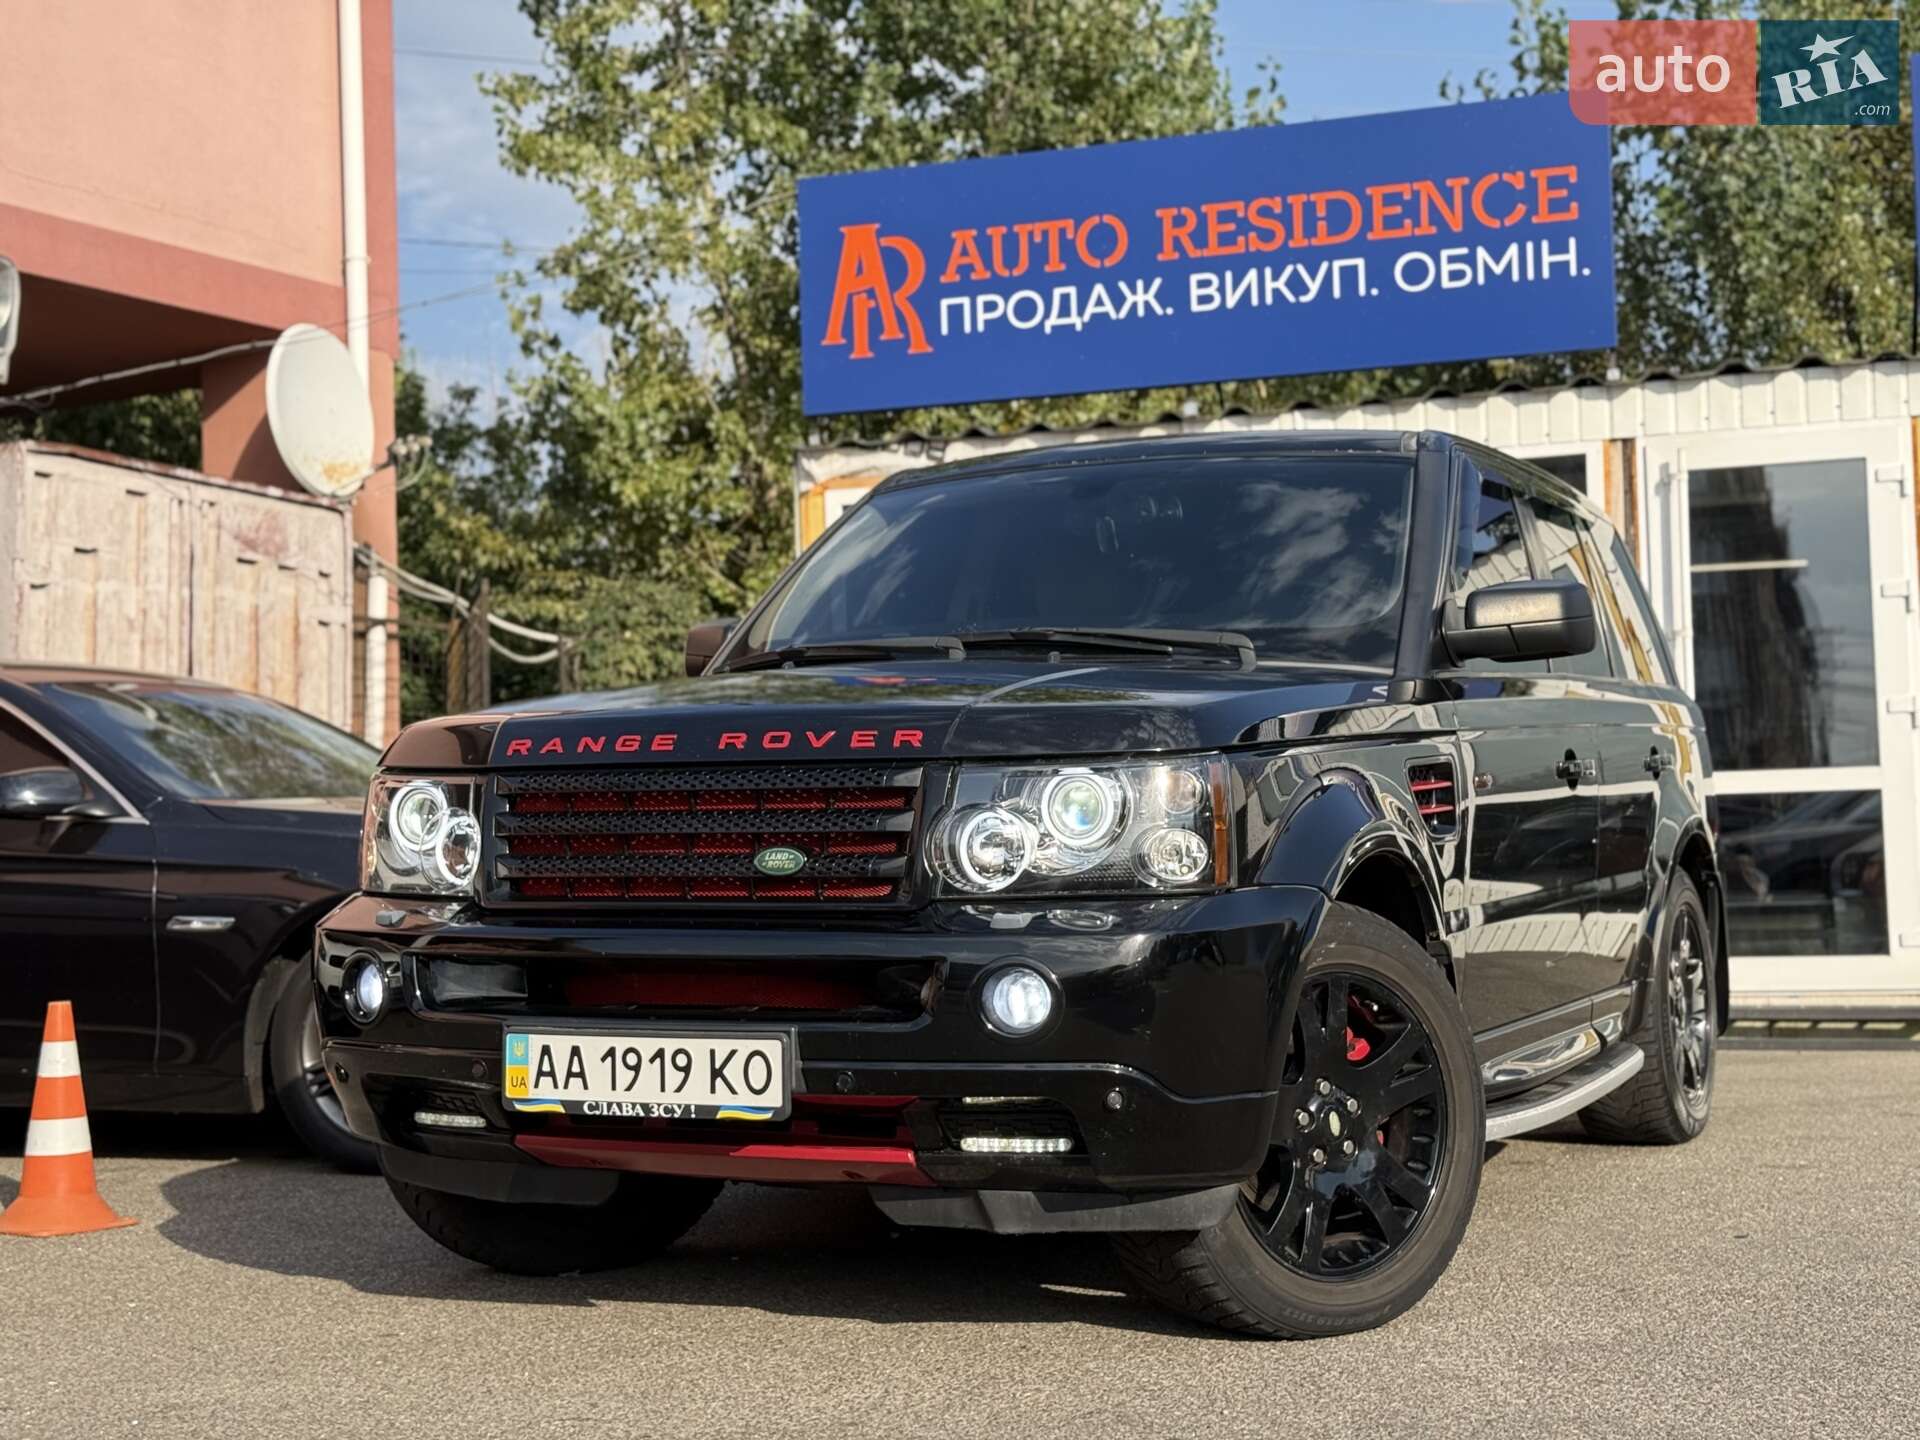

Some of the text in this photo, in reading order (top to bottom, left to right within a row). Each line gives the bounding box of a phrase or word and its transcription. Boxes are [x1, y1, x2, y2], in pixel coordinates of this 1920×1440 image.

[940, 165, 1580, 284] AUTO RESIDENCE
[939, 236, 1593, 336] ПРОДАЖ. ВИКУП. ОБМІН.
[506, 729, 926, 756] RANGE ROVER
[510, 1077, 528, 1089] UA
[533, 1044, 773, 1096] AA 1919 KO
[582, 1100, 646, 1117] СЛАВА
[648, 1102, 685, 1118] ЗСУ
